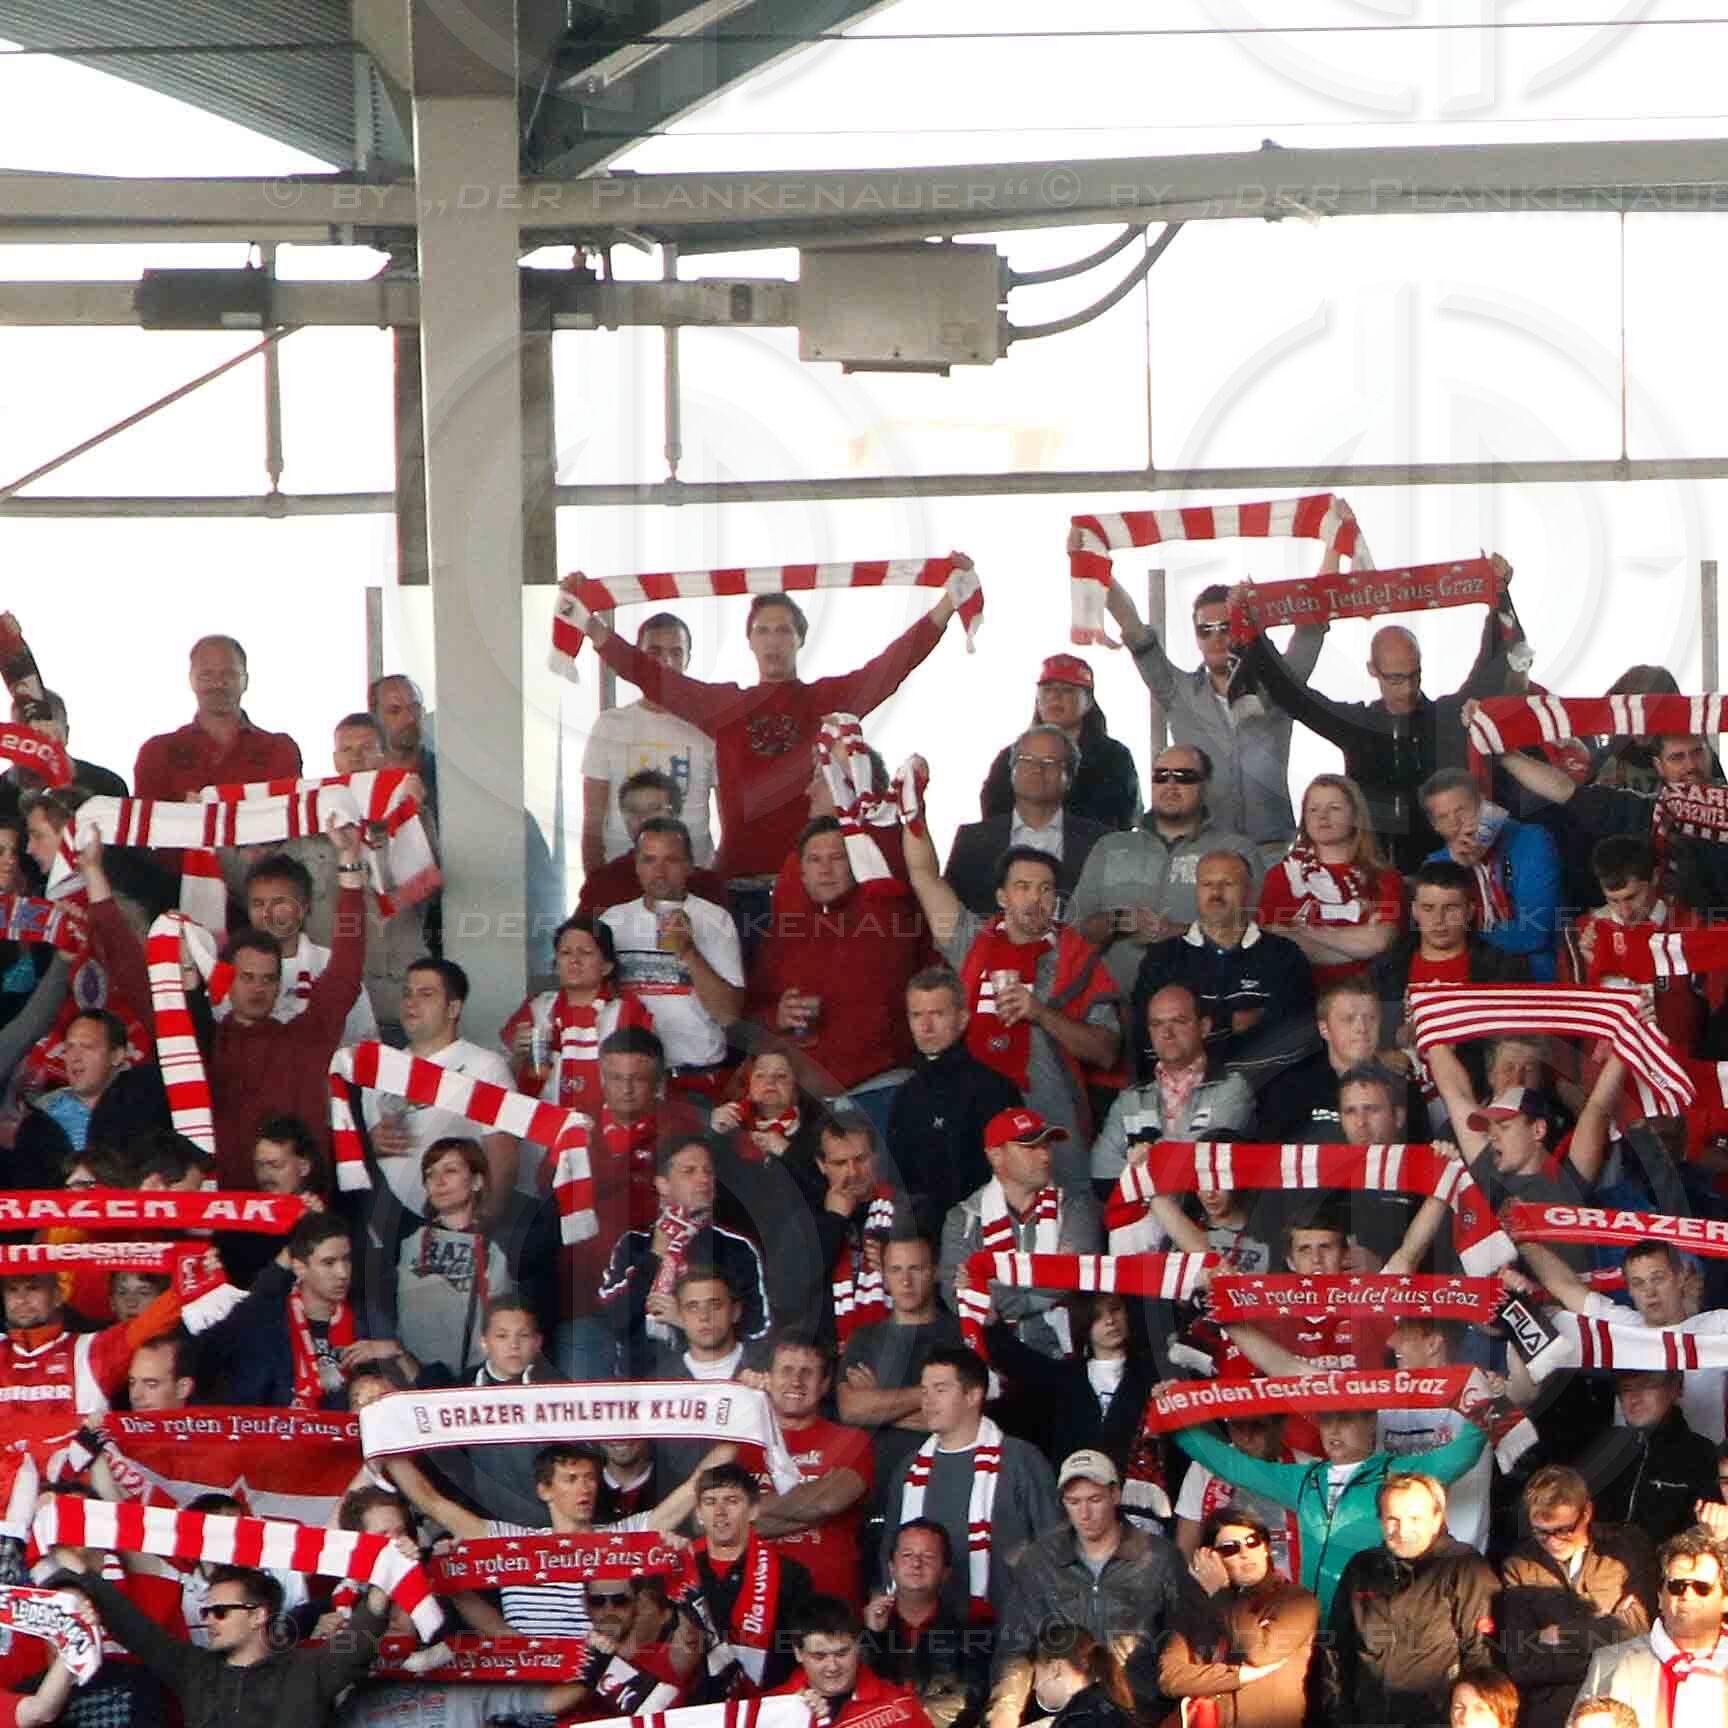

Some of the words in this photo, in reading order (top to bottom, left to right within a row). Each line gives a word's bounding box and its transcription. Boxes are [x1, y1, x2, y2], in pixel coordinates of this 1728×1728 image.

[1504, 1302, 1543, 1352] FILA
[1190, 1386, 1251, 1408] roten
[1253, 1377, 1338, 1400] Teufel
[1345, 1381, 1391, 1397] aus
[1396, 1373, 1448, 1396] Graz
[441, 1404, 525, 1427] GRAZER
[535, 1402, 640, 1425] ATHLETIK
[650, 1400, 708, 1422] KLUB
[476, 1551, 529, 1572] roten
[539, 1547, 601, 1570] Teufel
